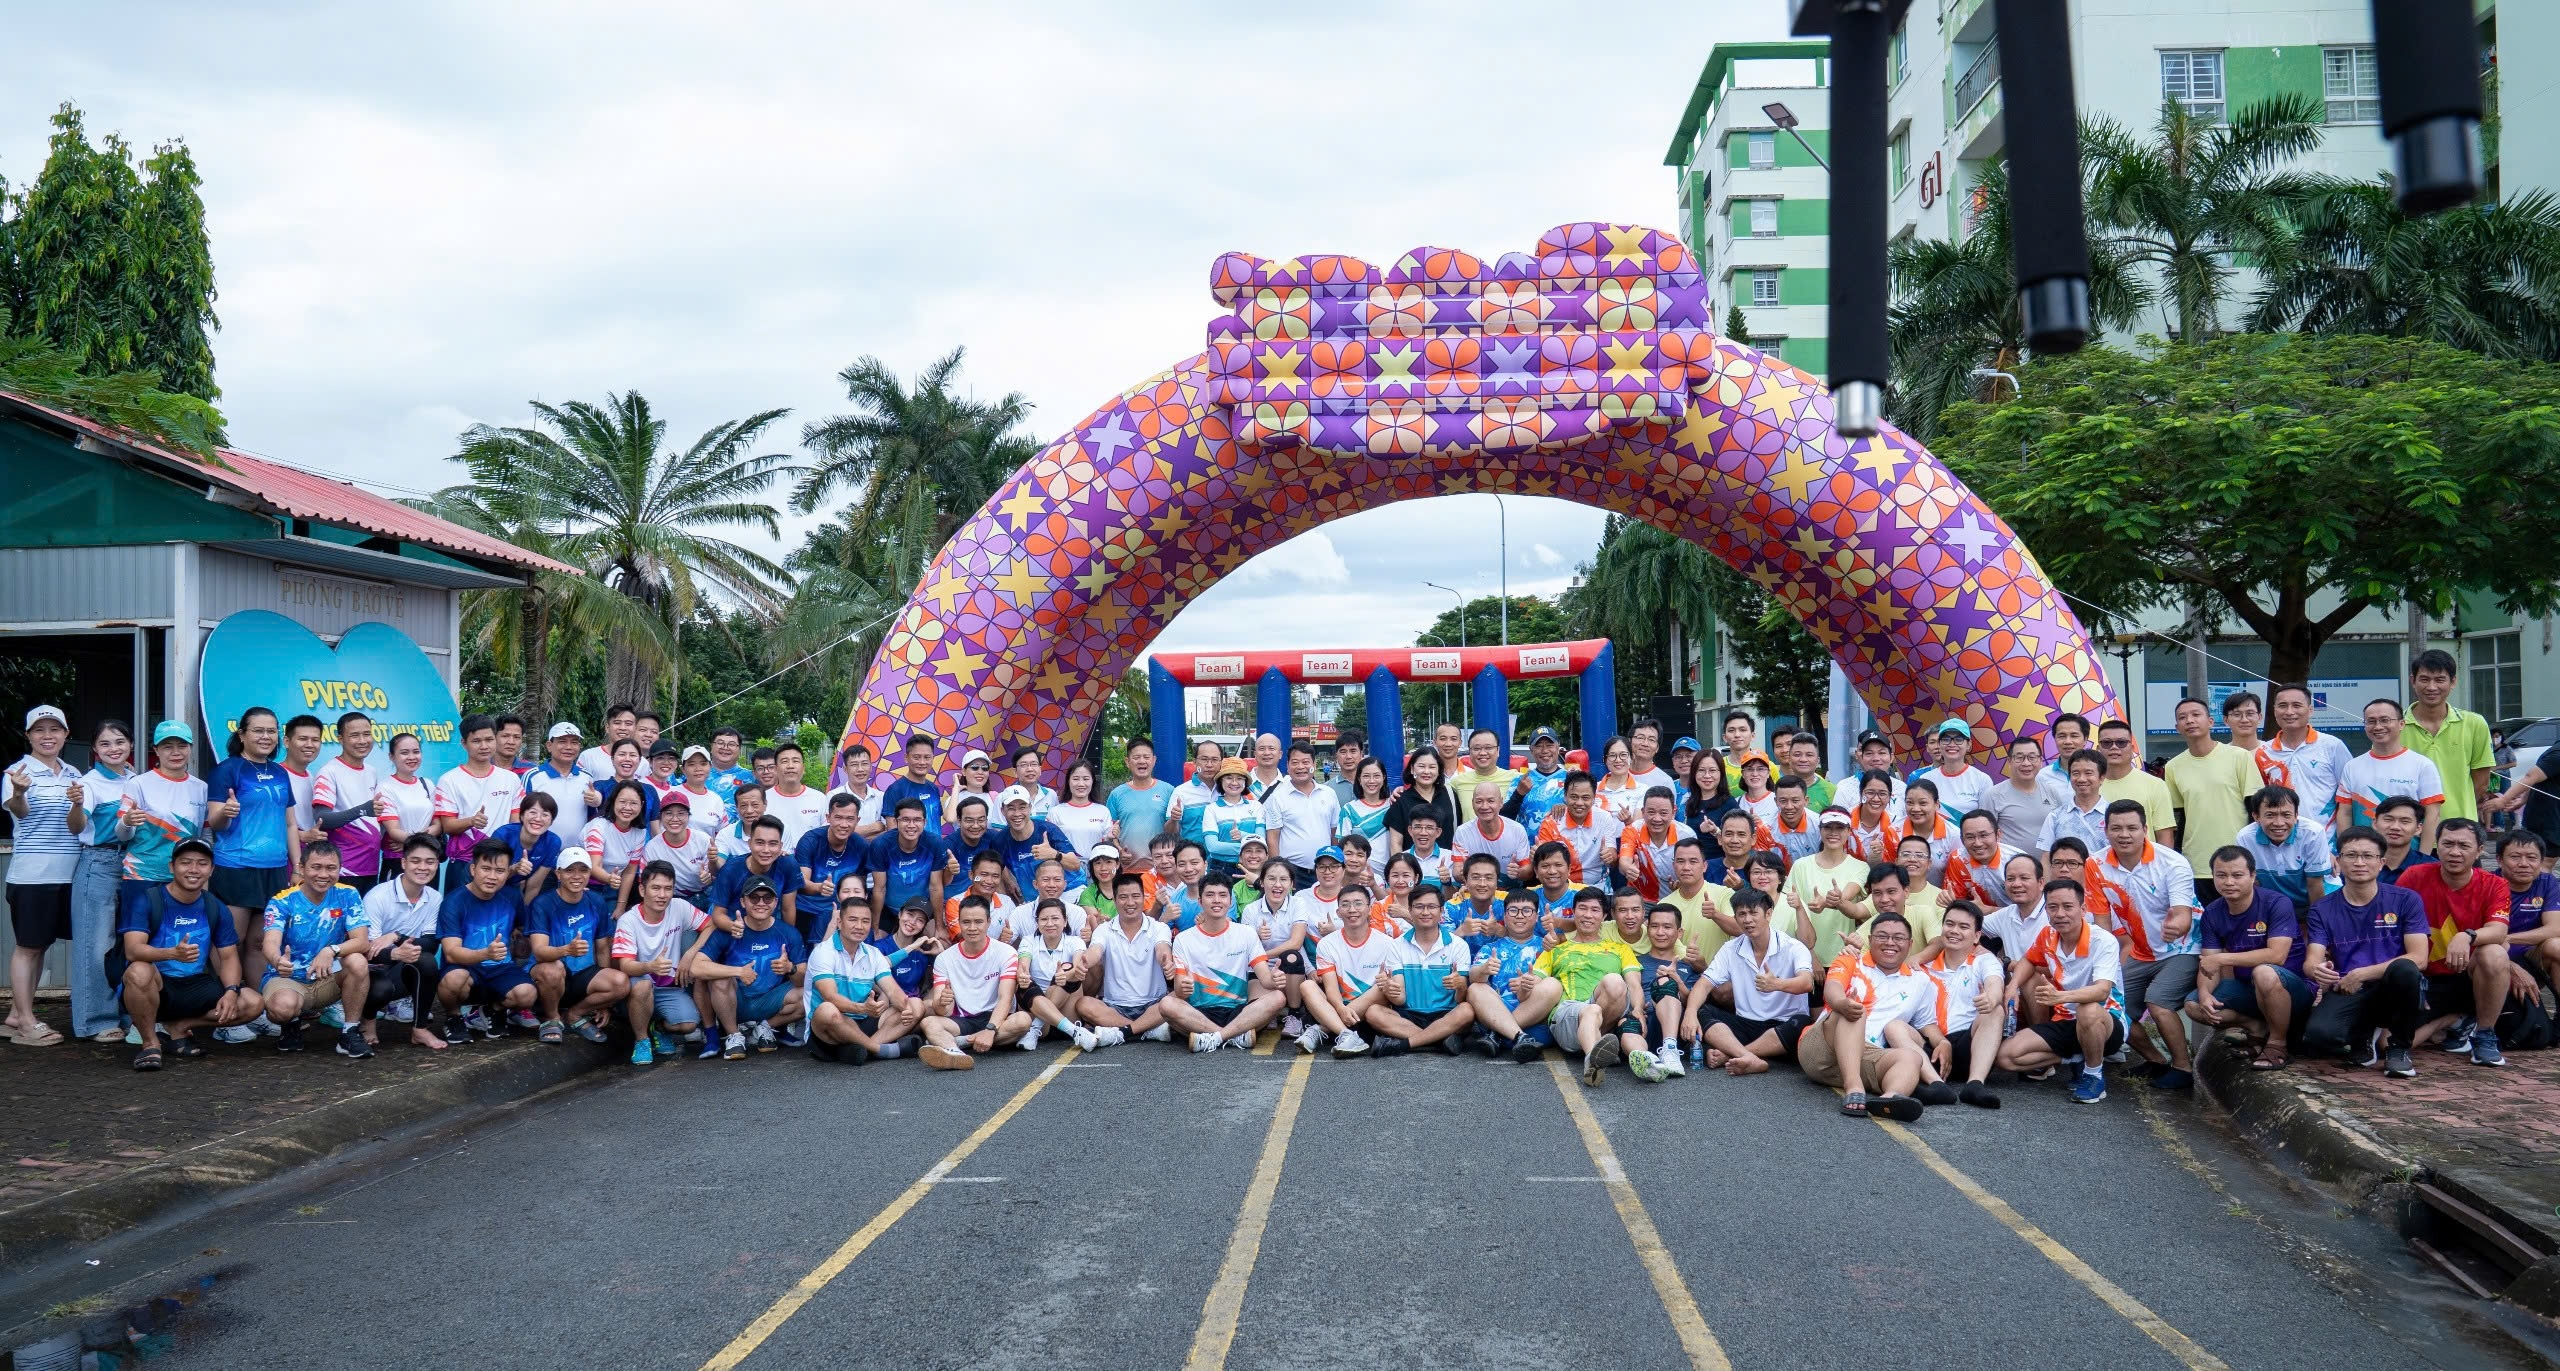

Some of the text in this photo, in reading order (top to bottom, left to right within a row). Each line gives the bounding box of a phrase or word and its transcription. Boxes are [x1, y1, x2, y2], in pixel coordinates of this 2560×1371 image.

[1307, 660, 1349, 670] Team 2
[1415, 659, 1458, 669] Team 3
[1524, 654, 1566, 666] Team 4
[1200, 662, 1241, 673] Team 1
[300, 680, 389, 709] PVFCCo
[371, 720, 389, 748] ỘT
